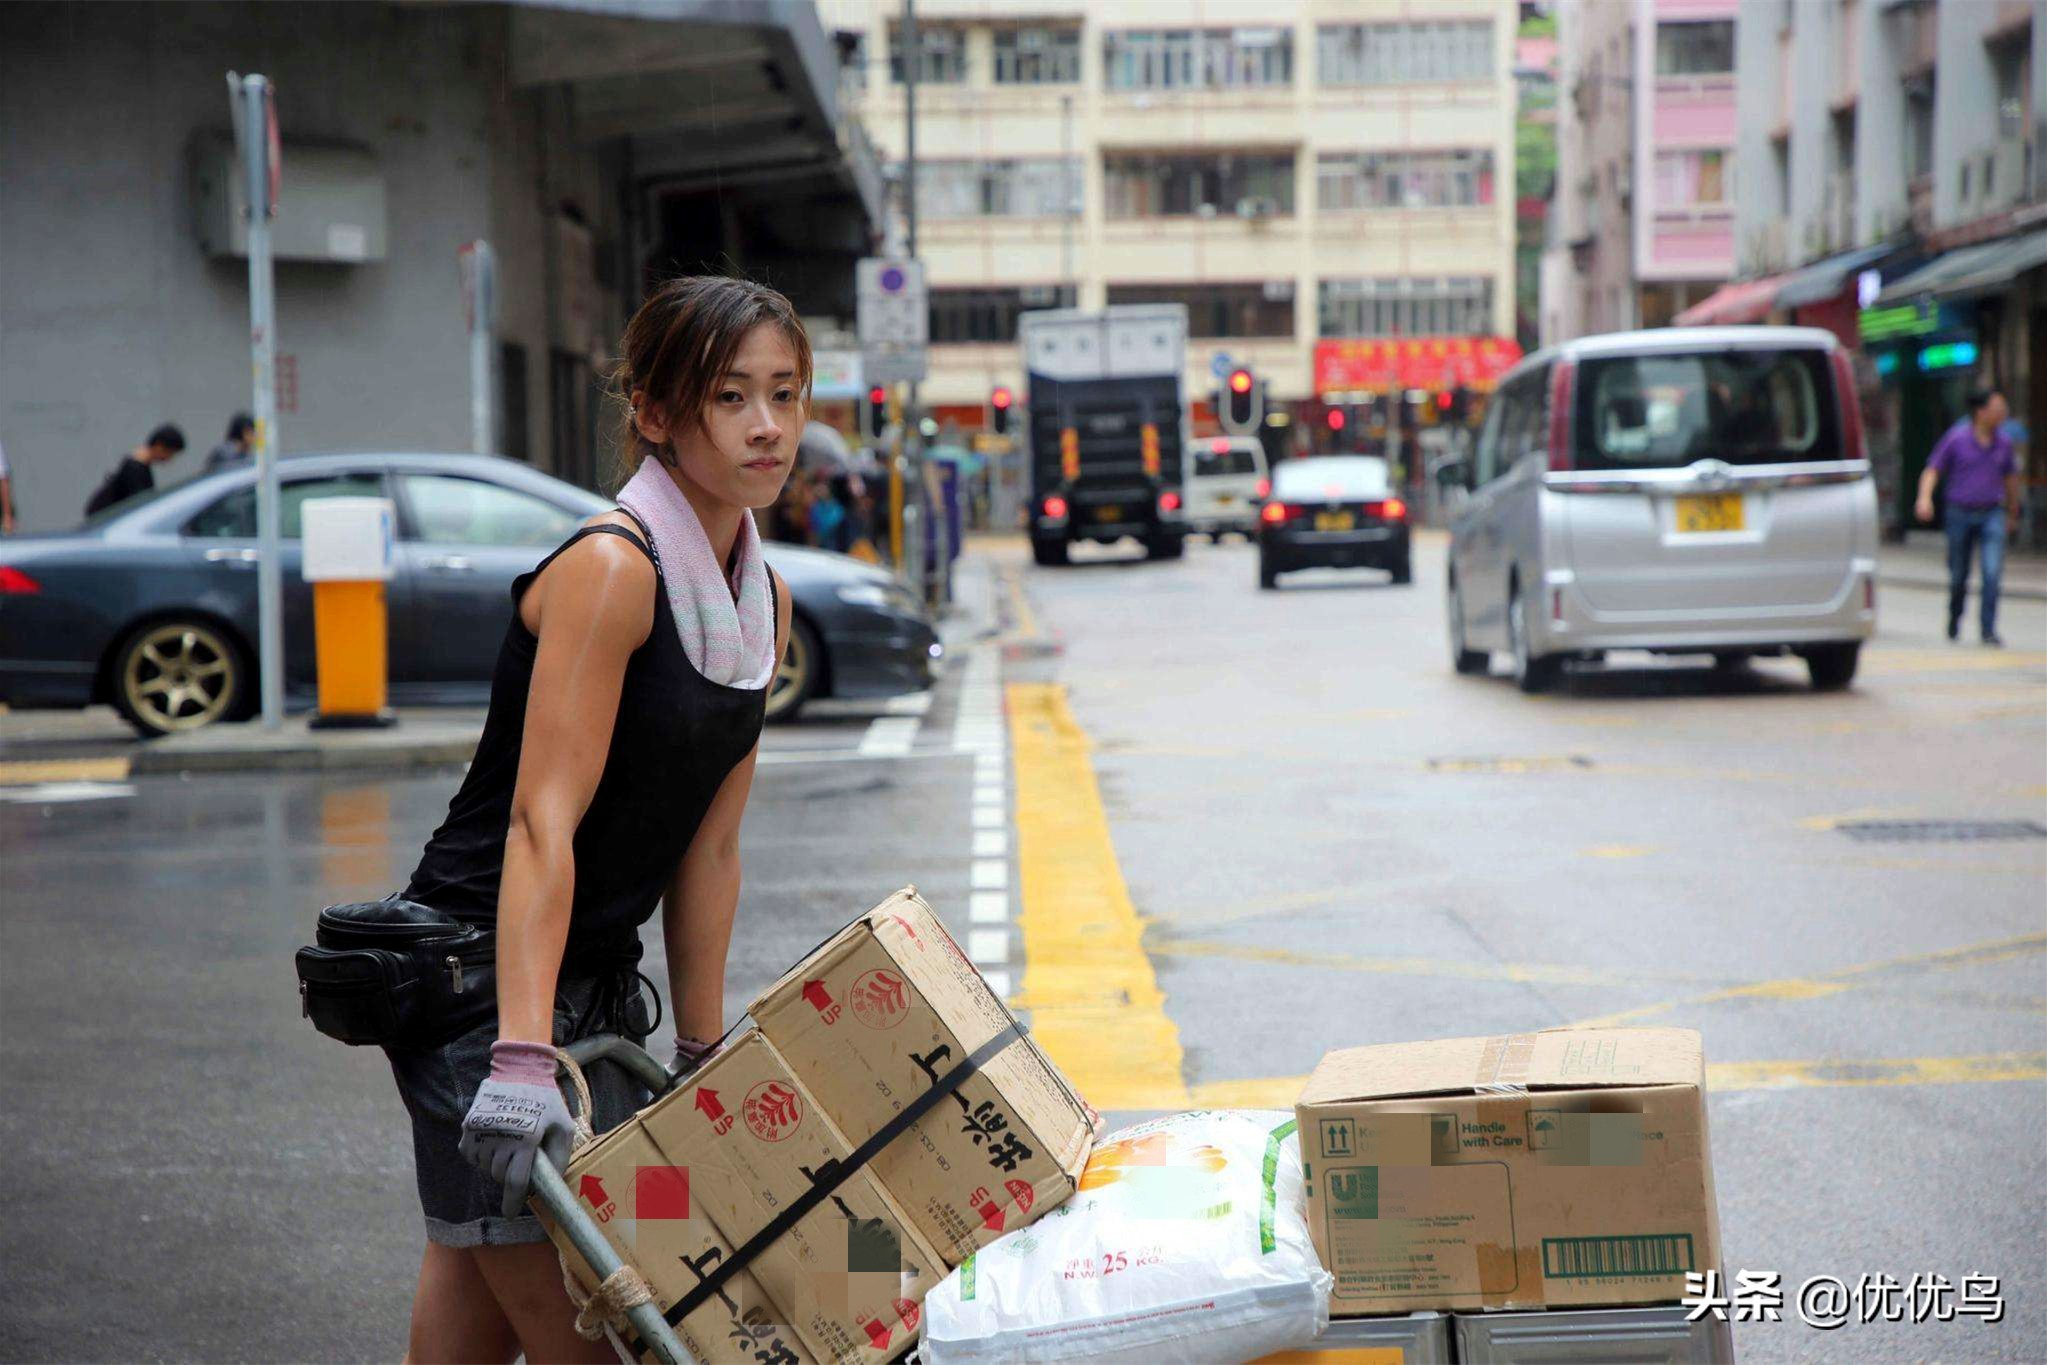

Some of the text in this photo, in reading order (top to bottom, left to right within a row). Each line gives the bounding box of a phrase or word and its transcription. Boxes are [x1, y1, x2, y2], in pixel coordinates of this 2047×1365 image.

[821, 1004, 843, 1026] UP
[714, 1115, 734, 1136] UP
[1462, 1121, 1506, 1134] Handle
[1462, 1136, 1522, 1147] with Care
[969, 1186, 990, 1208] UP
[596, 1202, 617, 1224] UP
[1102, 1250, 1128, 1276] 25
